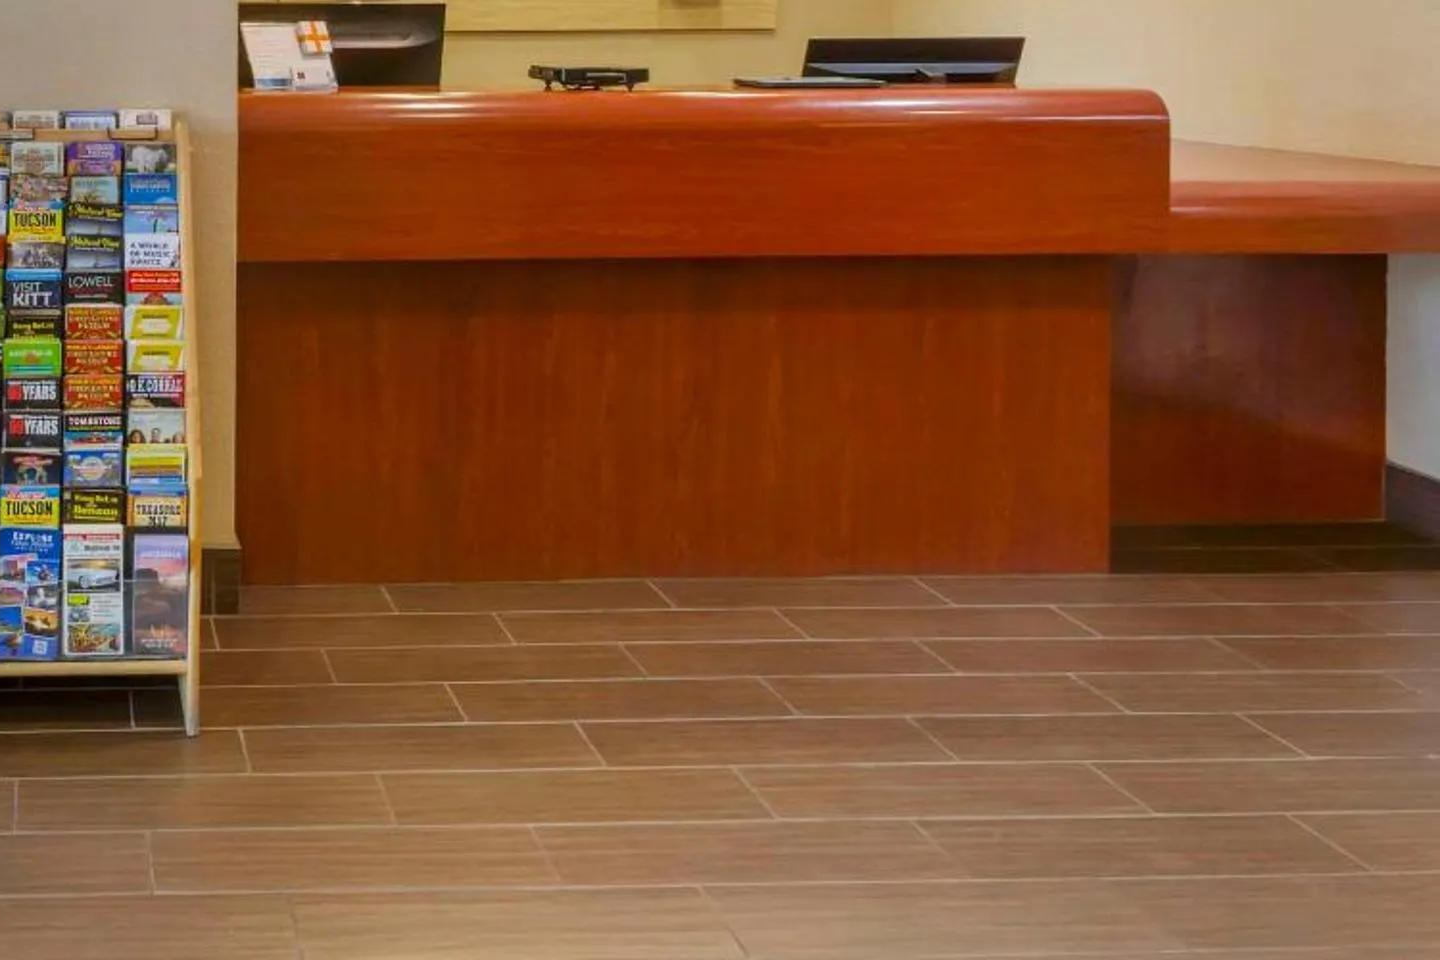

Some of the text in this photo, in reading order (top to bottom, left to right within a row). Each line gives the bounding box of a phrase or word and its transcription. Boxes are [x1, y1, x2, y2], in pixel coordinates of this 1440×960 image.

[14, 212, 57, 228] TUCSON
[13, 282, 42, 292] VISIT
[68, 276, 114, 289] LOWELL
[13, 292, 53, 307] KITT
[23, 383, 57, 400] YEARS
[24, 418, 59, 436] YEARS
[7, 501, 53, 516] TUCSON
